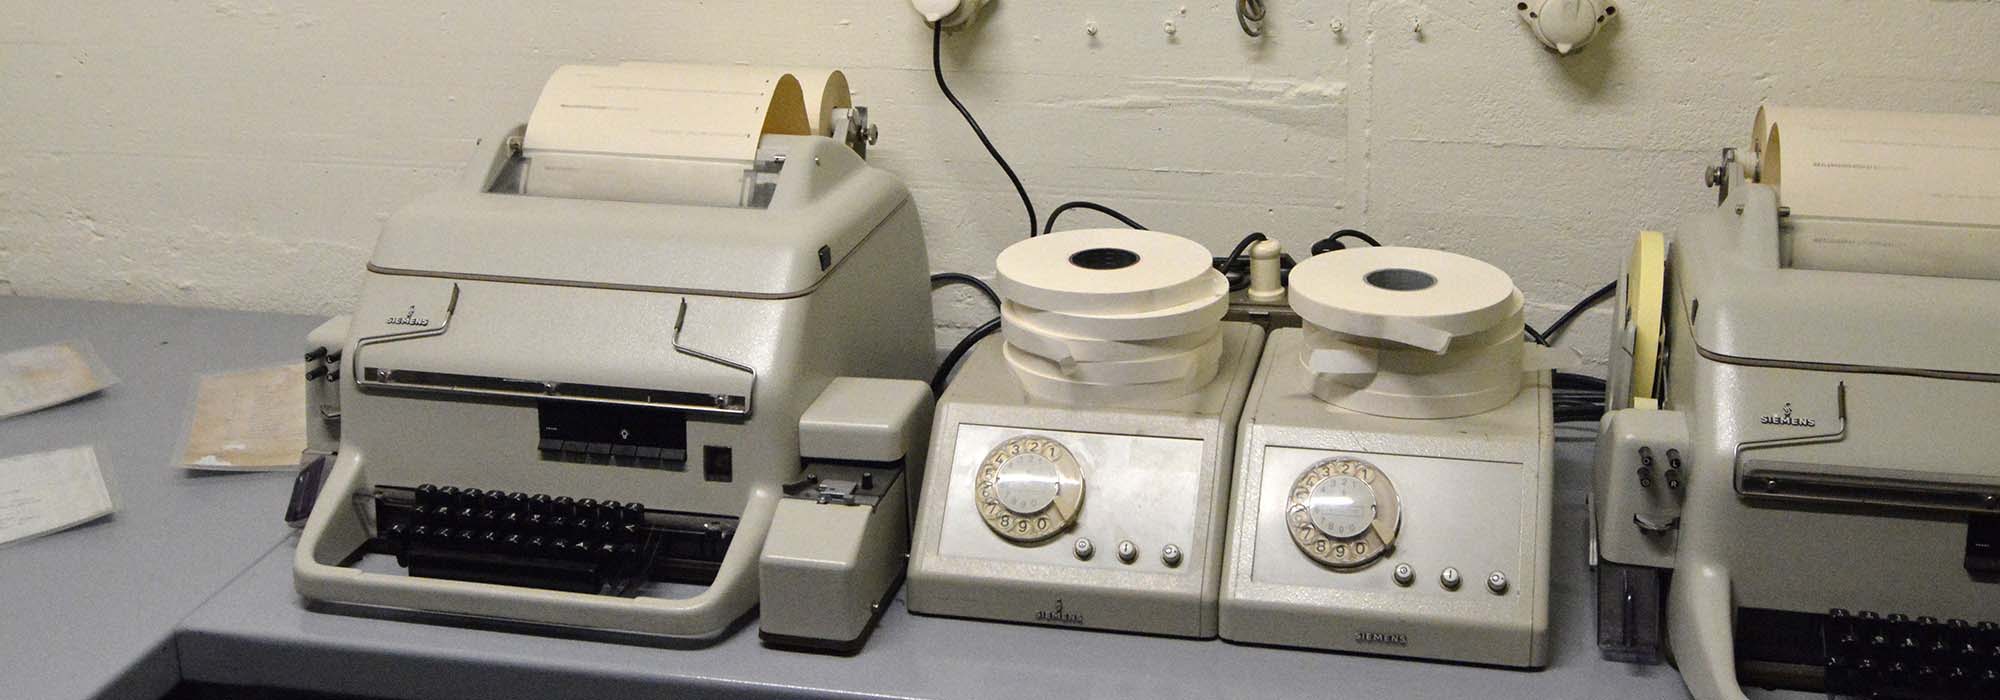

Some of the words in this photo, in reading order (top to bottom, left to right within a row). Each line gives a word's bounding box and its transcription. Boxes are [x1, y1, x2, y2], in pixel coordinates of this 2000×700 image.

[387, 317, 429, 327] SIEMENS
[1760, 416, 1815, 427] SIEMENS
[1018, 520, 1028, 532] 9
[1037, 517, 1047, 530] 0
[1336, 545, 1345, 557] 9
[1355, 543, 1365, 554] 0
[1353, 632, 1408, 645] SIEMENS
